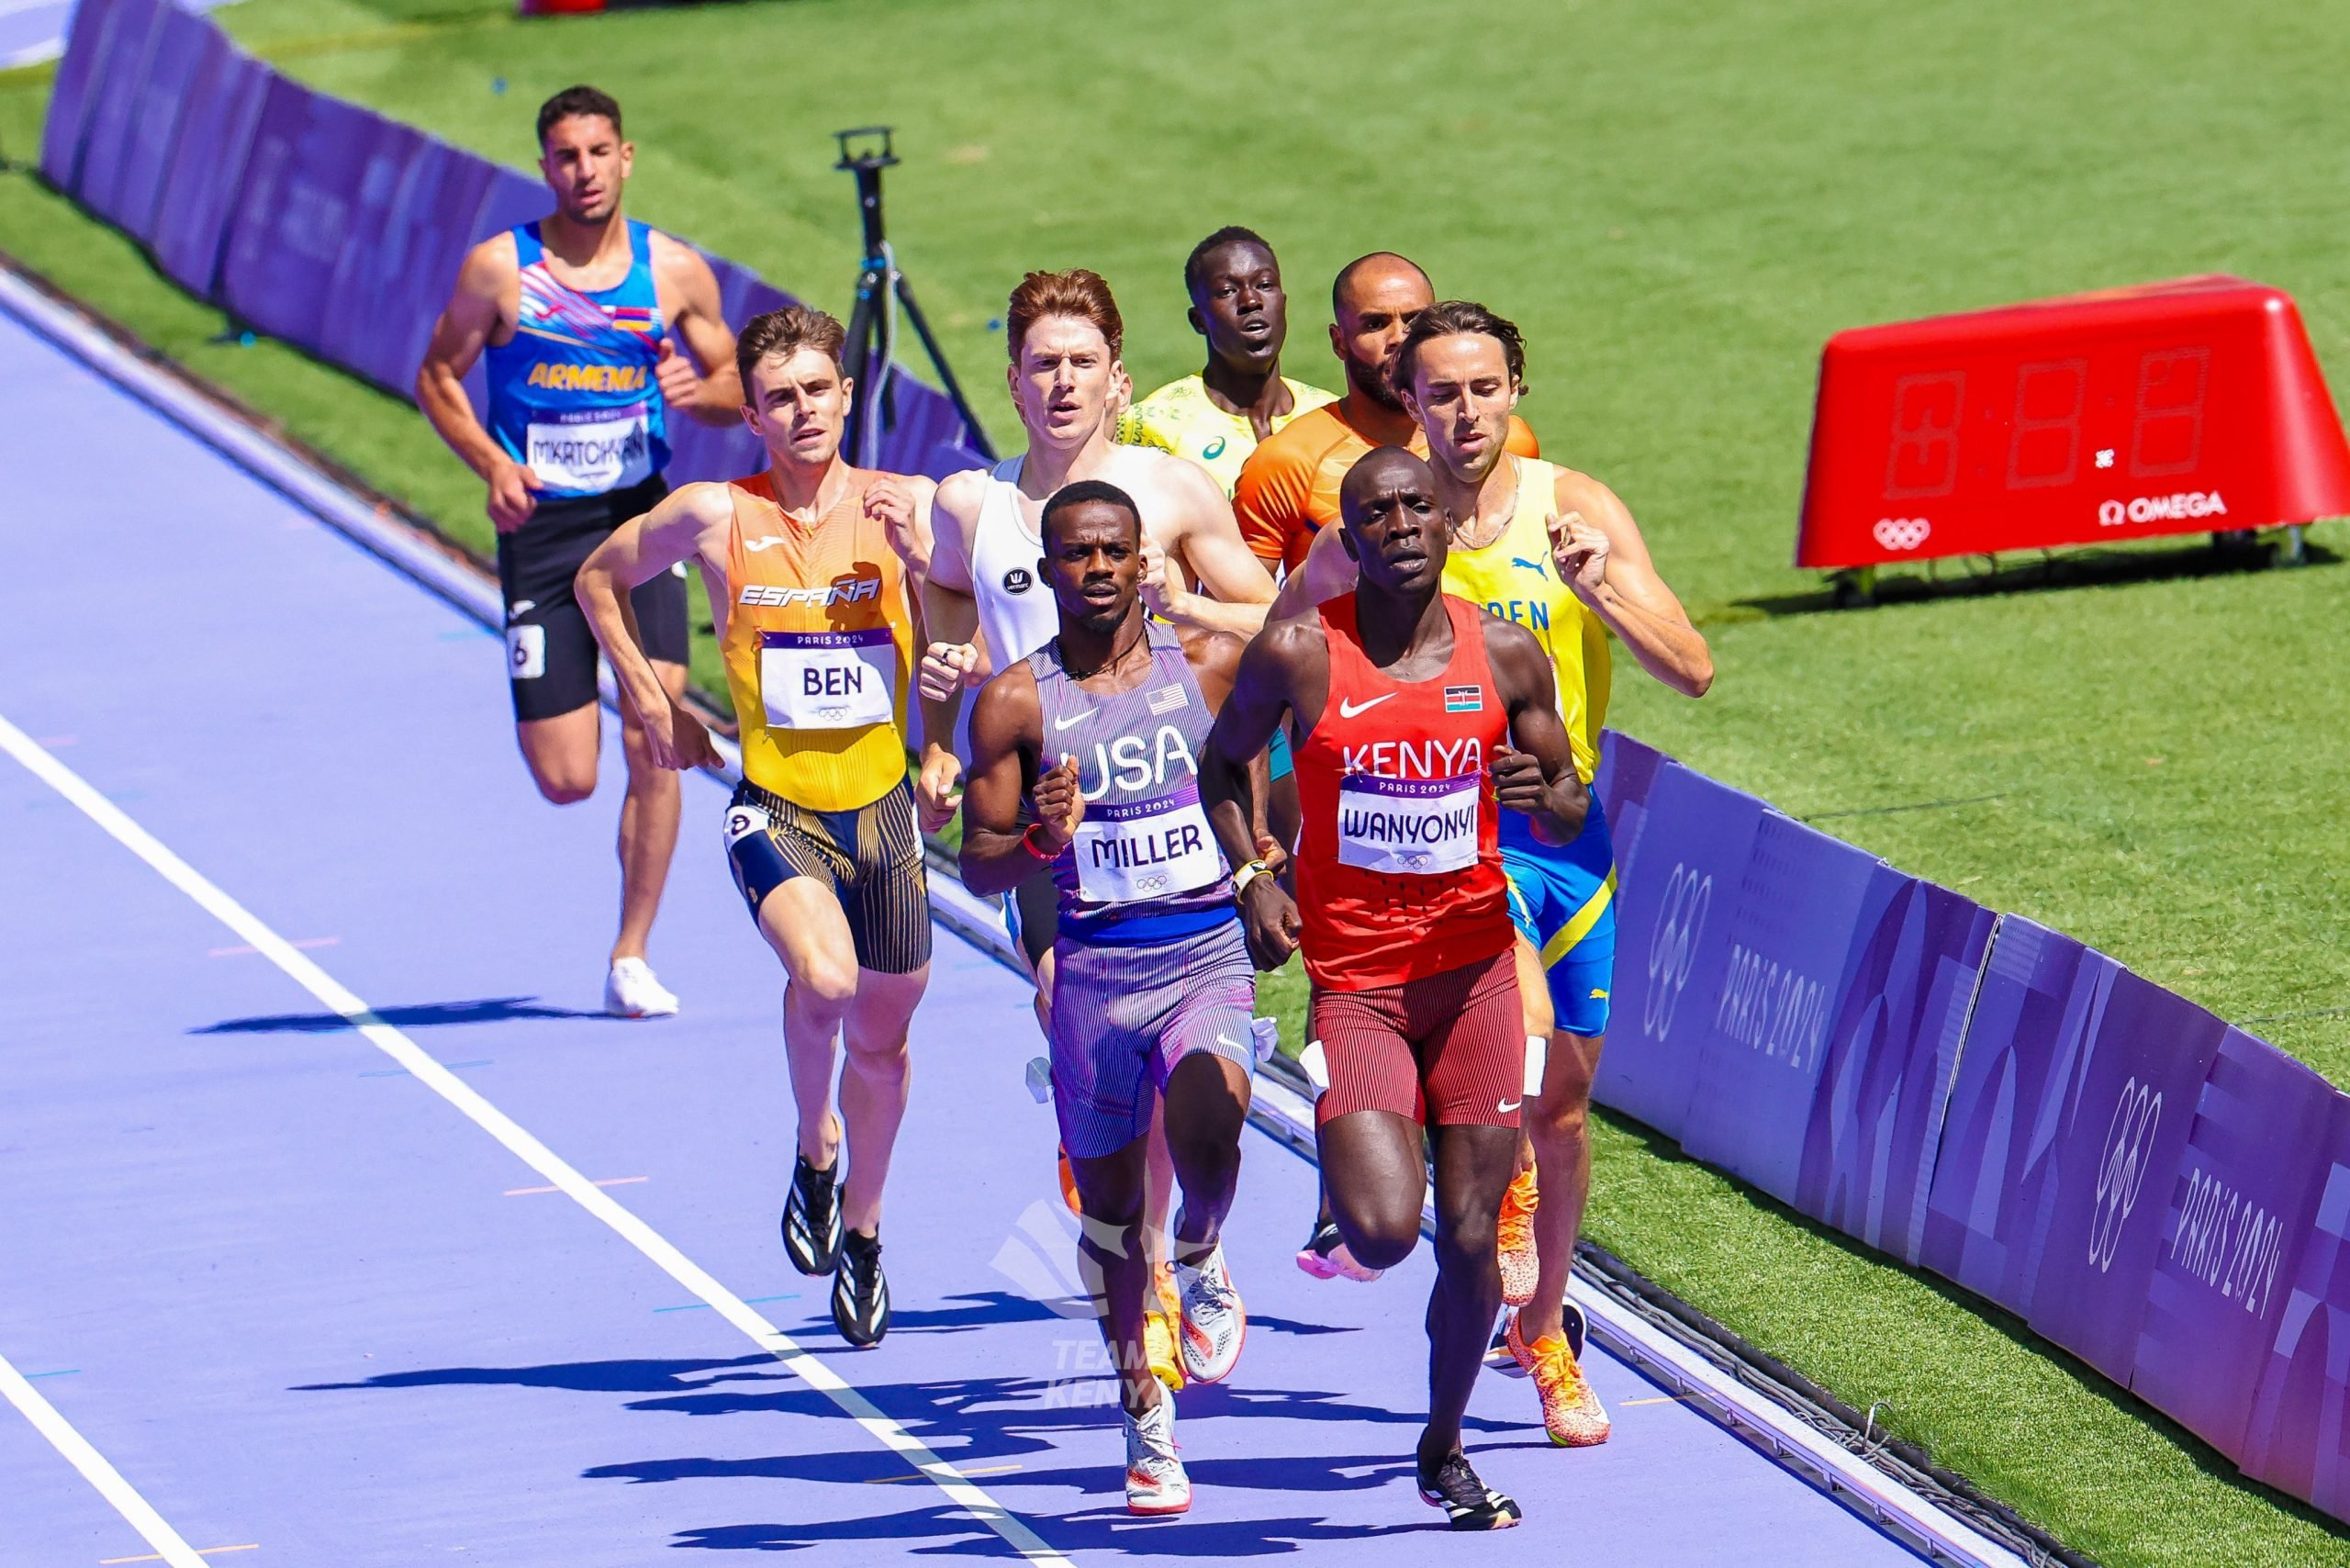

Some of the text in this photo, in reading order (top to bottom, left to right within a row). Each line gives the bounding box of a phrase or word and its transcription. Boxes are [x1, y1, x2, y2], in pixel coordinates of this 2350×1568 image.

[527, 362, 647, 392] ARMENIA
[2127, 489, 2228, 523] OMEGA
[739, 578, 881, 609] ESPAÑA
[514, 637, 528, 666] 6
[797, 634, 864, 644] PARIS 2024
[803, 666, 862, 696] BEN
[1060, 724, 1199, 801] USA
[1343, 737, 1482, 779] KENYA
[1379, 781, 1451, 795] PARIS 2024
[1106, 798, 1176, 818] PARIS 2024
[1345, 804, 1475, 845] WANYONYI
[1091, 823, 1203, 868] MILLER
[1717, 944, 1826, 1074] PARIS 2024
[2170, 1167, 2284, 1321] PARIS 2024
